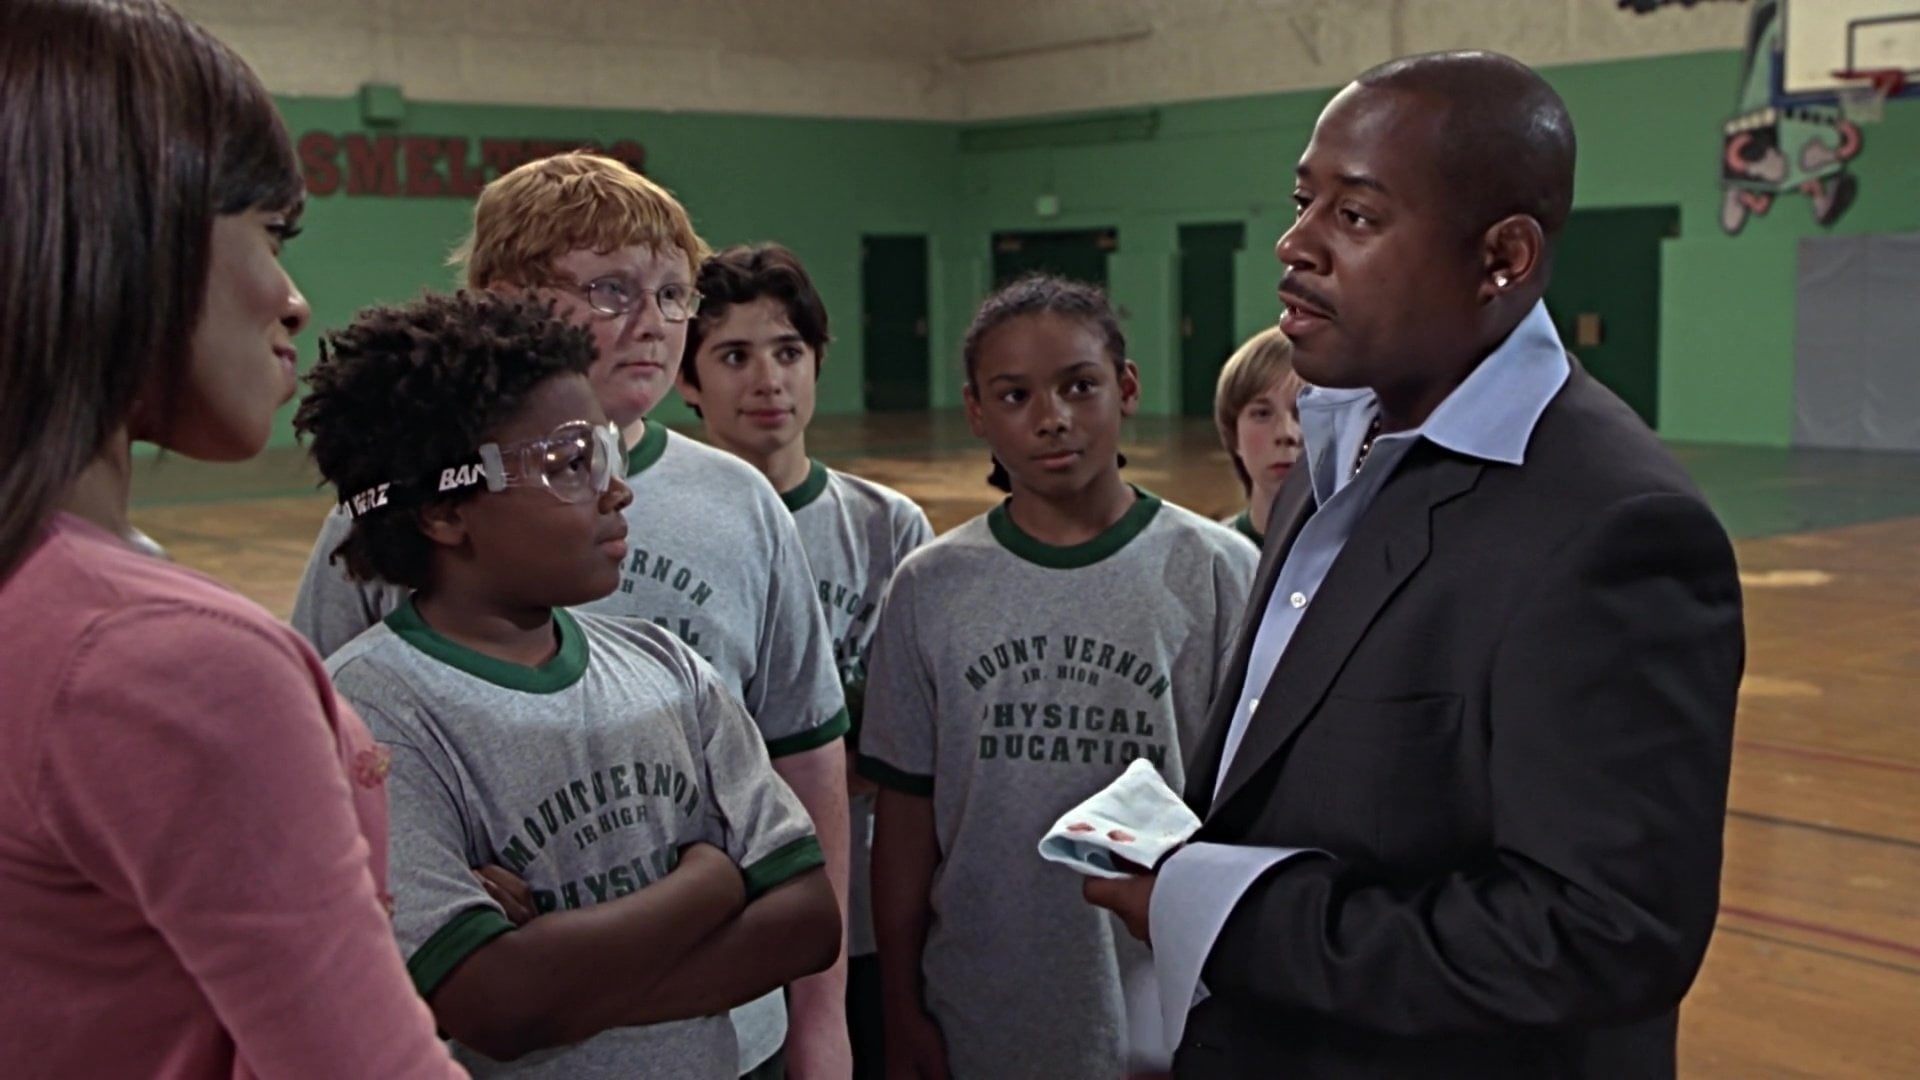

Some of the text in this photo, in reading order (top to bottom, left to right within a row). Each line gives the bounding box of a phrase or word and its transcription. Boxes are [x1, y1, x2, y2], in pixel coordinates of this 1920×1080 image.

[620, 548, 713, 606] RNON
[965, 635, 1170, 699] MOUNT VERNON
[1057, 665, 1099, 686] HIGH
[983, 703, 1154, 737] HYSICAL
[501, 778, 592, 873] MOUNT
